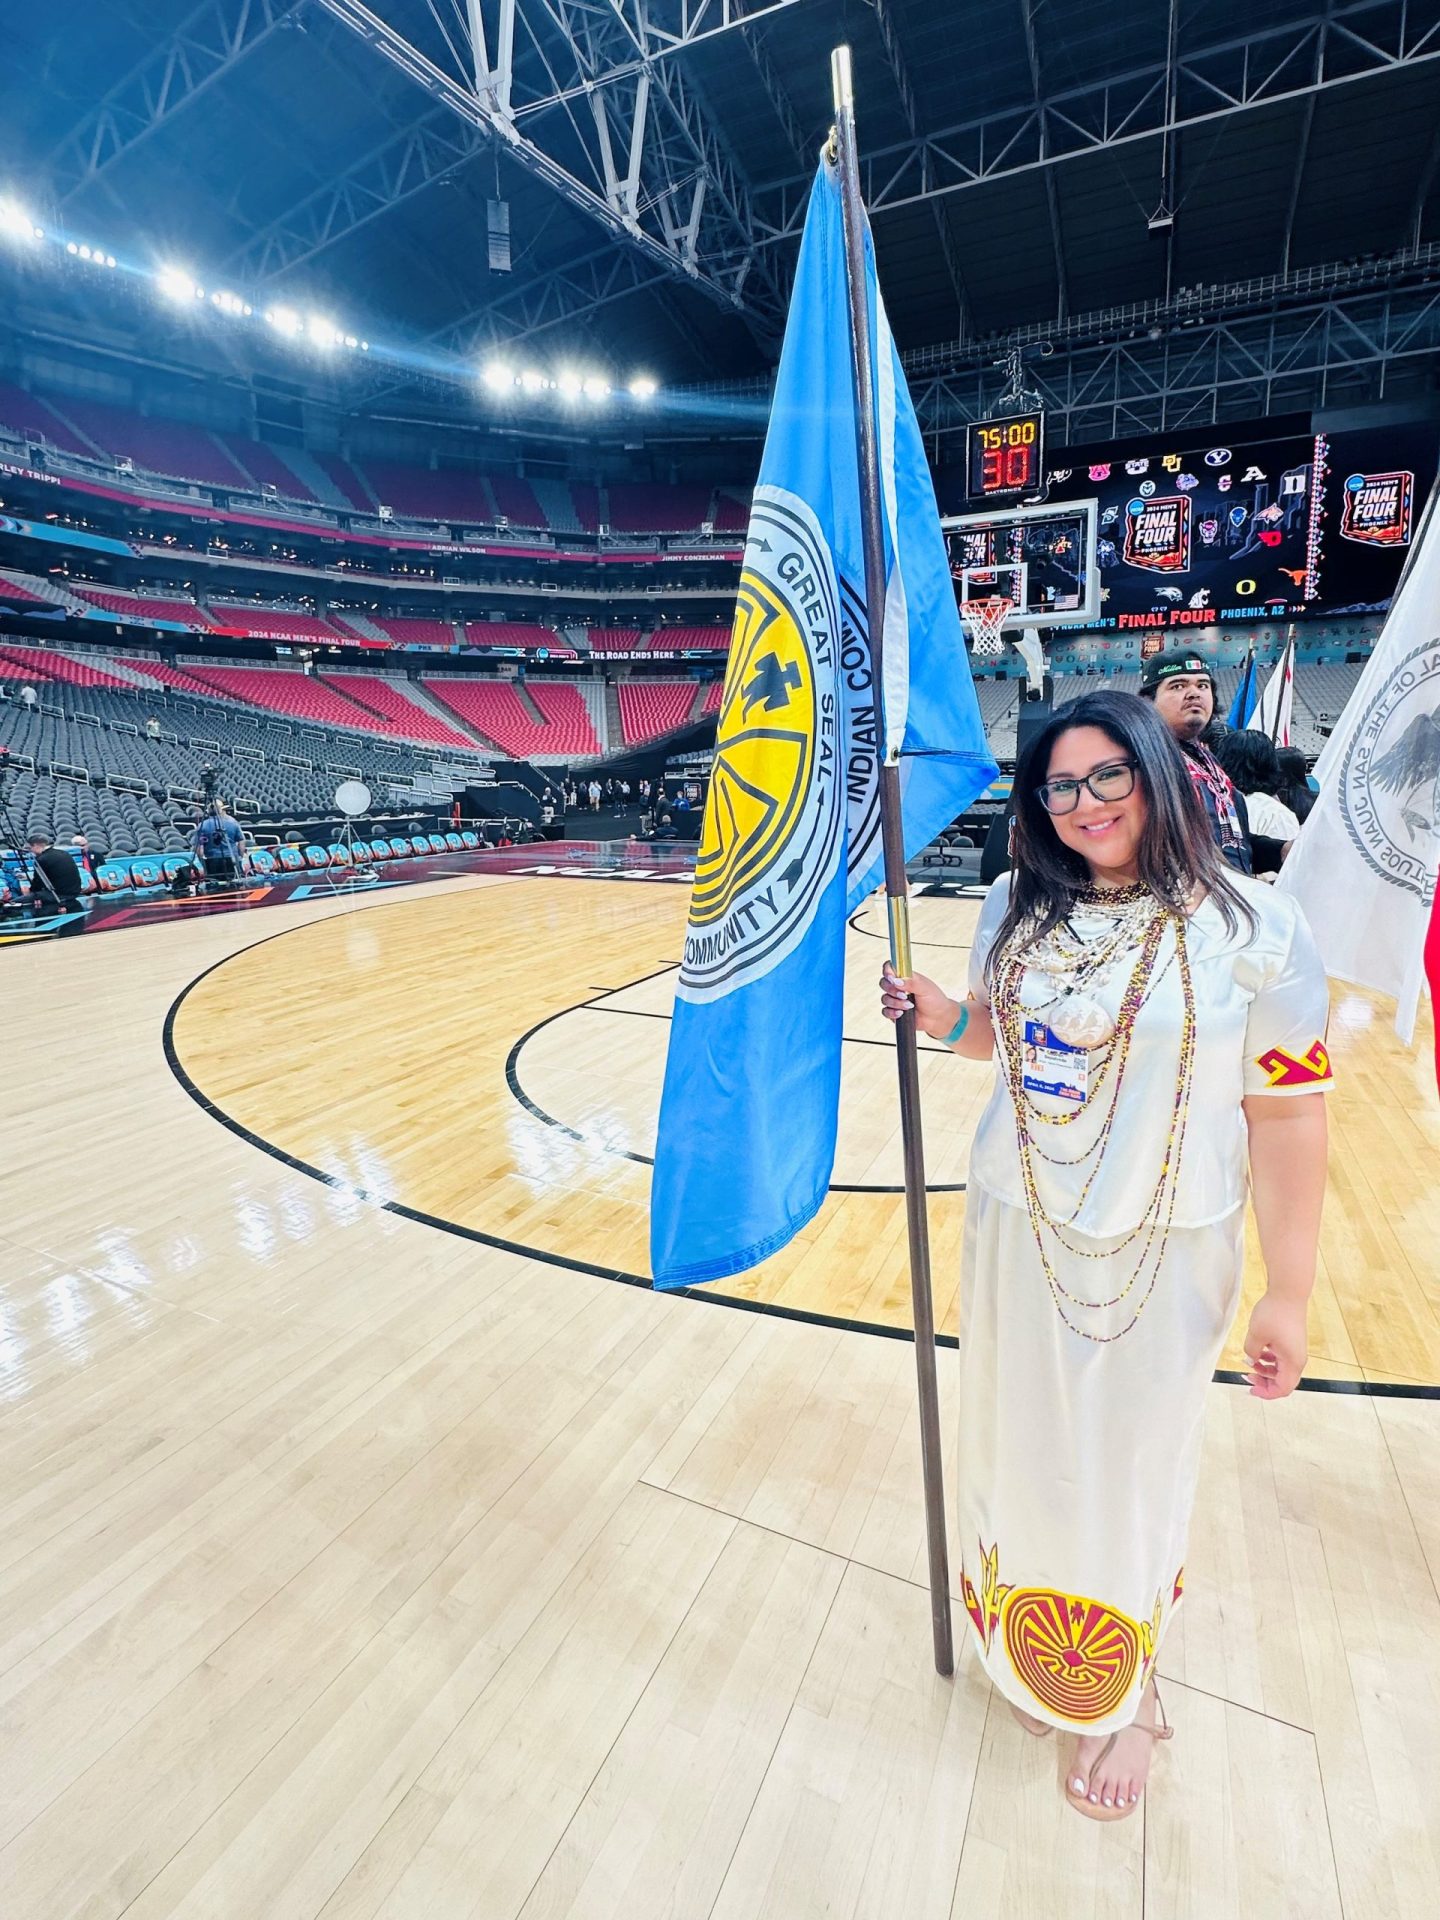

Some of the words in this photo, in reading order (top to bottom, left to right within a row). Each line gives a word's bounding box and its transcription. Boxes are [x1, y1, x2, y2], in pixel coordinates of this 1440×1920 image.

[977, 422, 1035, 449] 75:00
[27, 470, 61, 485] TRIPPI
[983, 447, 1028, 489] 30
[1353, 486, 1398, 506] FINAL
[1135, 510, 1177, 530] FINAL
[1352, 502, 1398, 520] FOUR
[1134, 527, 1176, 545] FOUR
[1118, 612, 1167, 628] FINAL
[1170, 609, 1216, 625] FOUR
[1221, 606, 1268, 619] PHOENIX,
[1271, 605, 1285, 615] AZ
[248, 630, 268, 639] 2024
[270, 631, 291, 640] NCAA
[293, 634, 317, 643] MEN'S
[319, 636, 340, 645] FINAL
[341, 638, 361, 646] FOUR
[589, 651, 605, 659] THE
[606, 651, 628, 659] ROAD
[630, 651, 652, 659] ENDS
[653, 651, 674, 659] HERE
[777, 552, 832, 669] GREAT
[817, 693, 834, 783] SEAL
[847, 705, 877, 804] INDIAN
[684, 885, 779, 965] COMMUNITY
